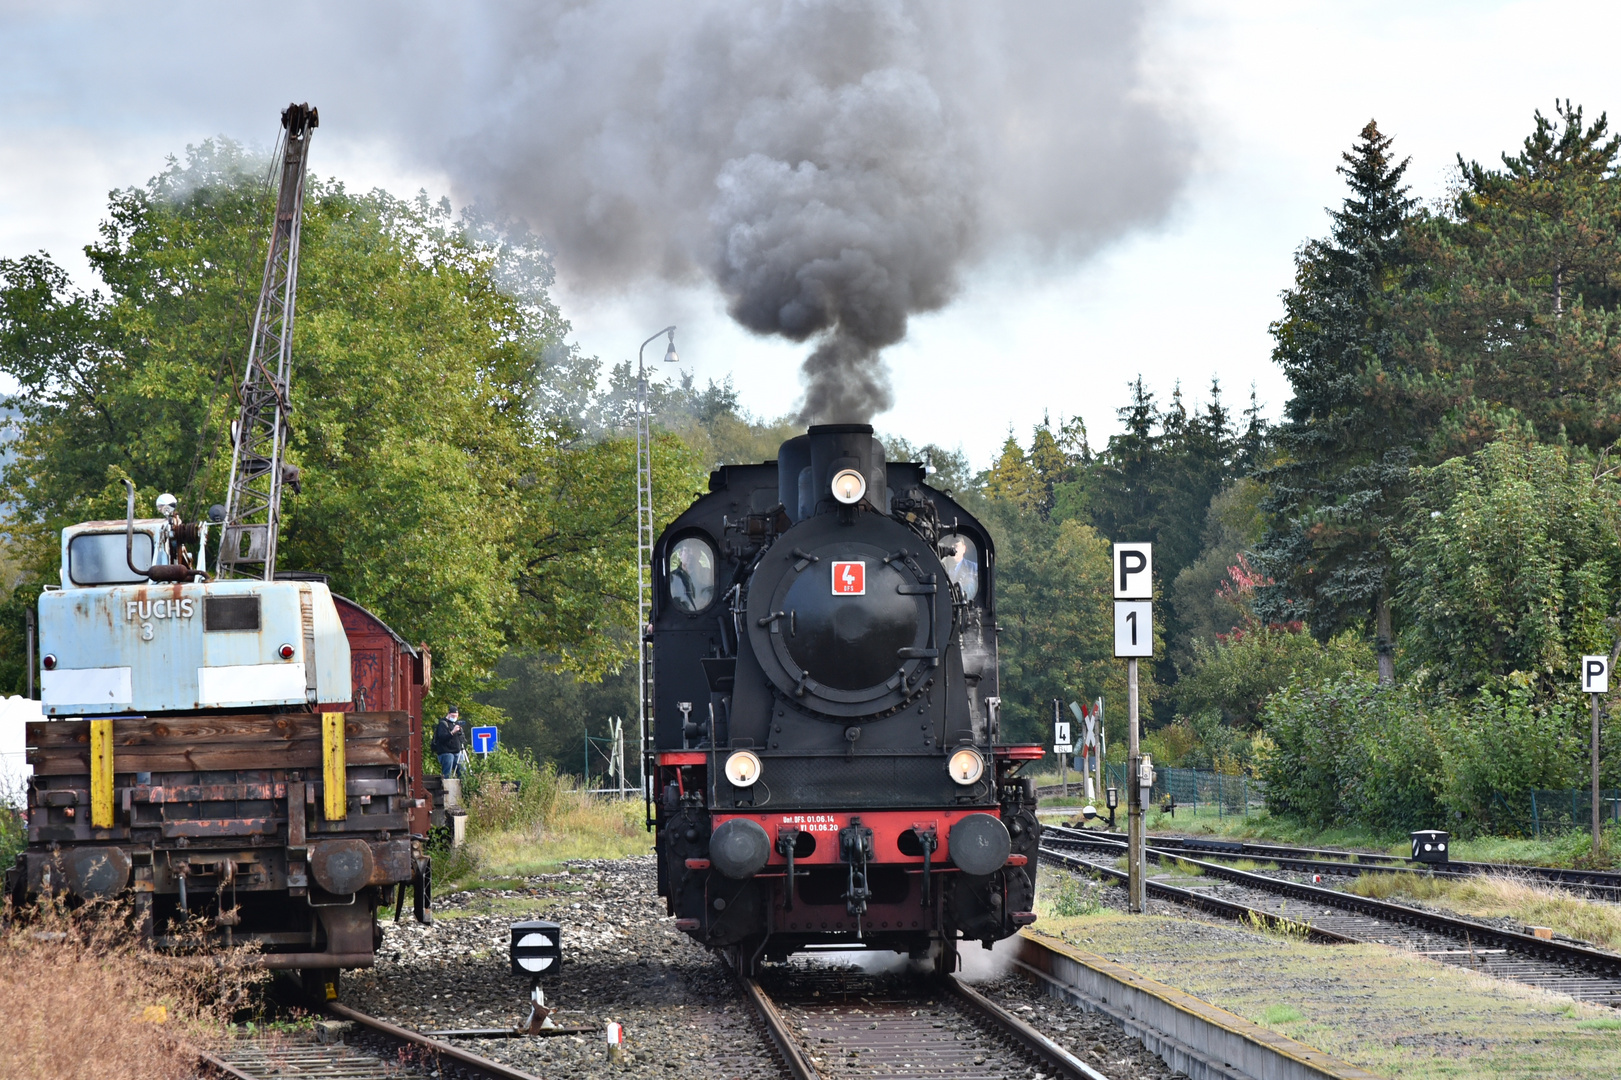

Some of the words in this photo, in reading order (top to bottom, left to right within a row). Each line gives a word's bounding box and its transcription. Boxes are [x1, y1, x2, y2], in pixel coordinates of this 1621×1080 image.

[842, 565, 855, 585] 4
[1120, 550, 1147, 591] P
[126, 599, 194, 620] FUCHS
[141, 622, 154, 641] 3
[1126, 611, 1137, 646] 1
[1586, 660, 1605, 688] P
[1059, 725, 1067, 741] 4
[807, 815, 835, 823] 01.06.14
